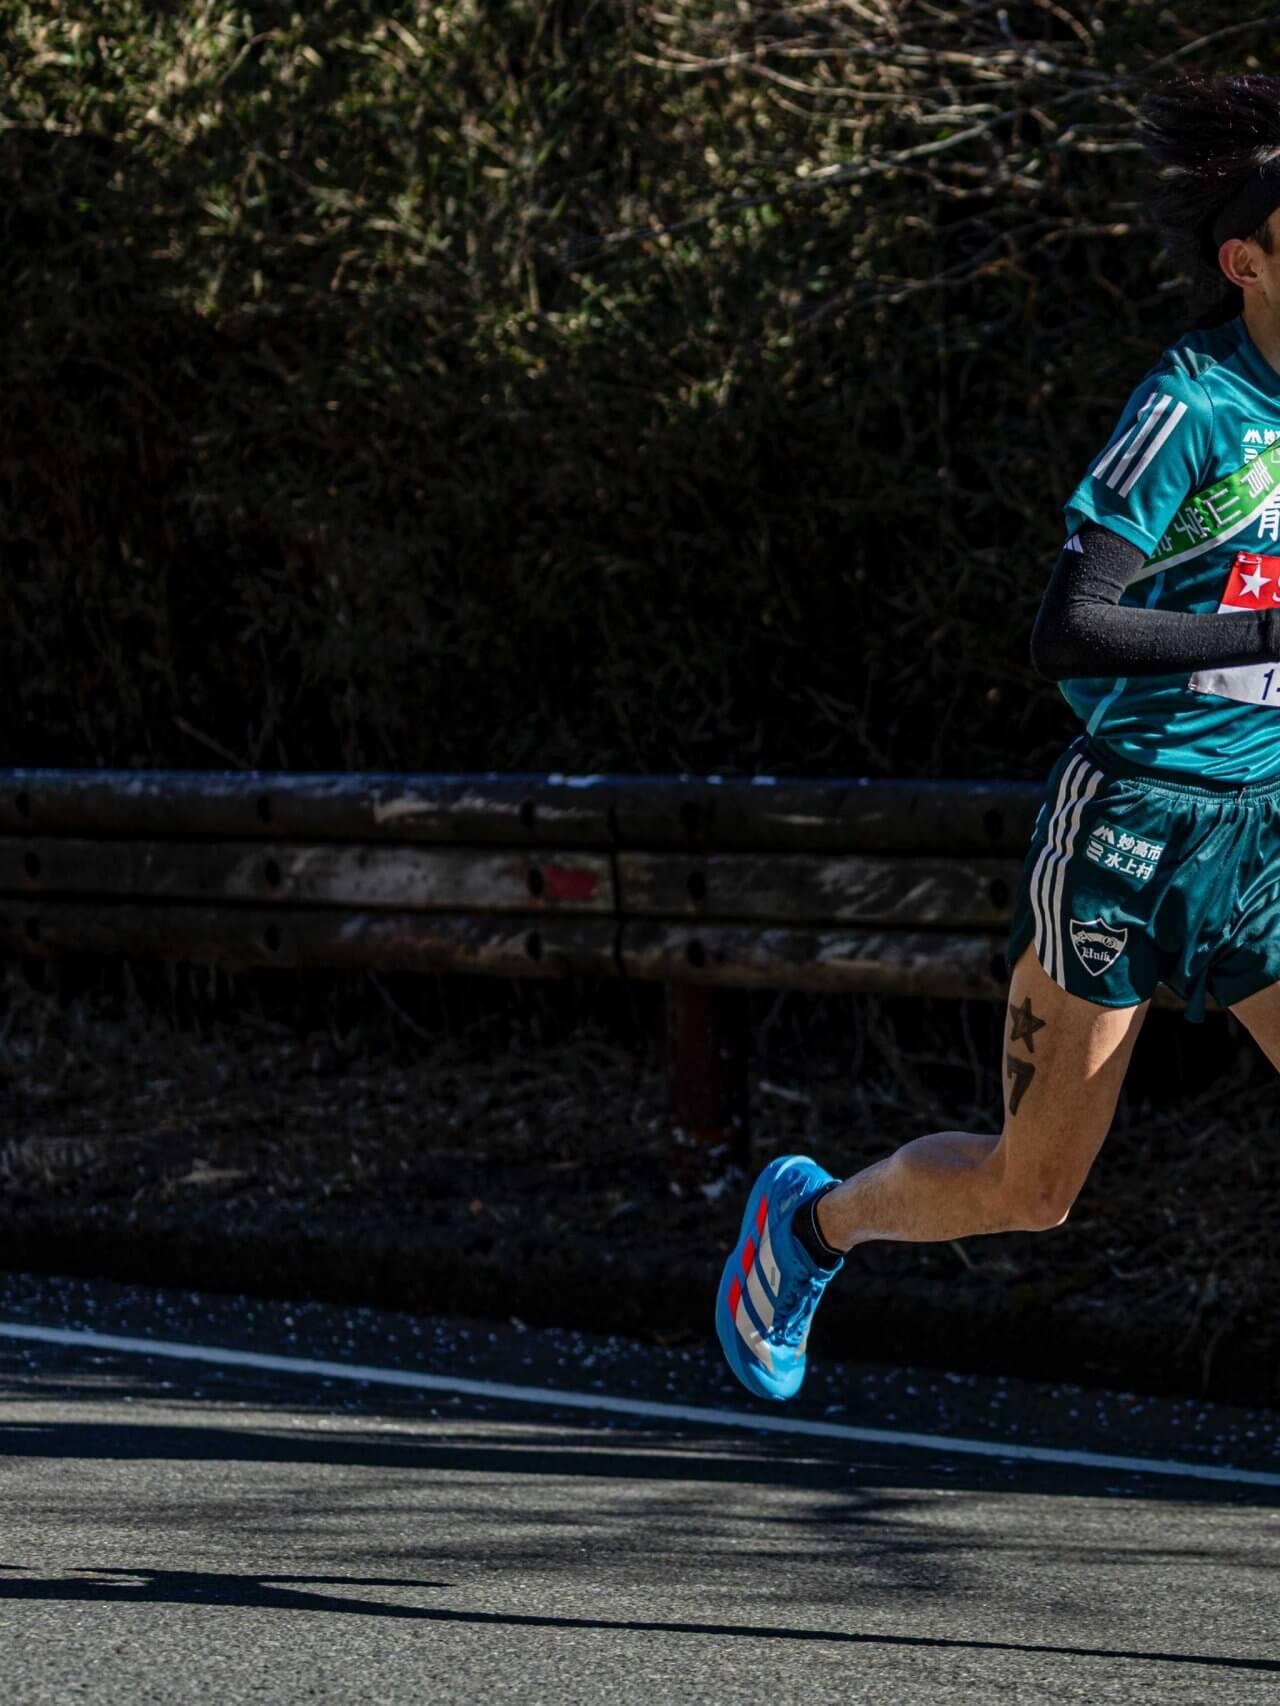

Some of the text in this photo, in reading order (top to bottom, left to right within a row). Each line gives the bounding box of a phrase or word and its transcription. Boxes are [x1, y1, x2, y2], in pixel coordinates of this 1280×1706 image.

[1117, 833, 1164, 862] 妙高市
[1104, 852, 1154, 880] 水上村
